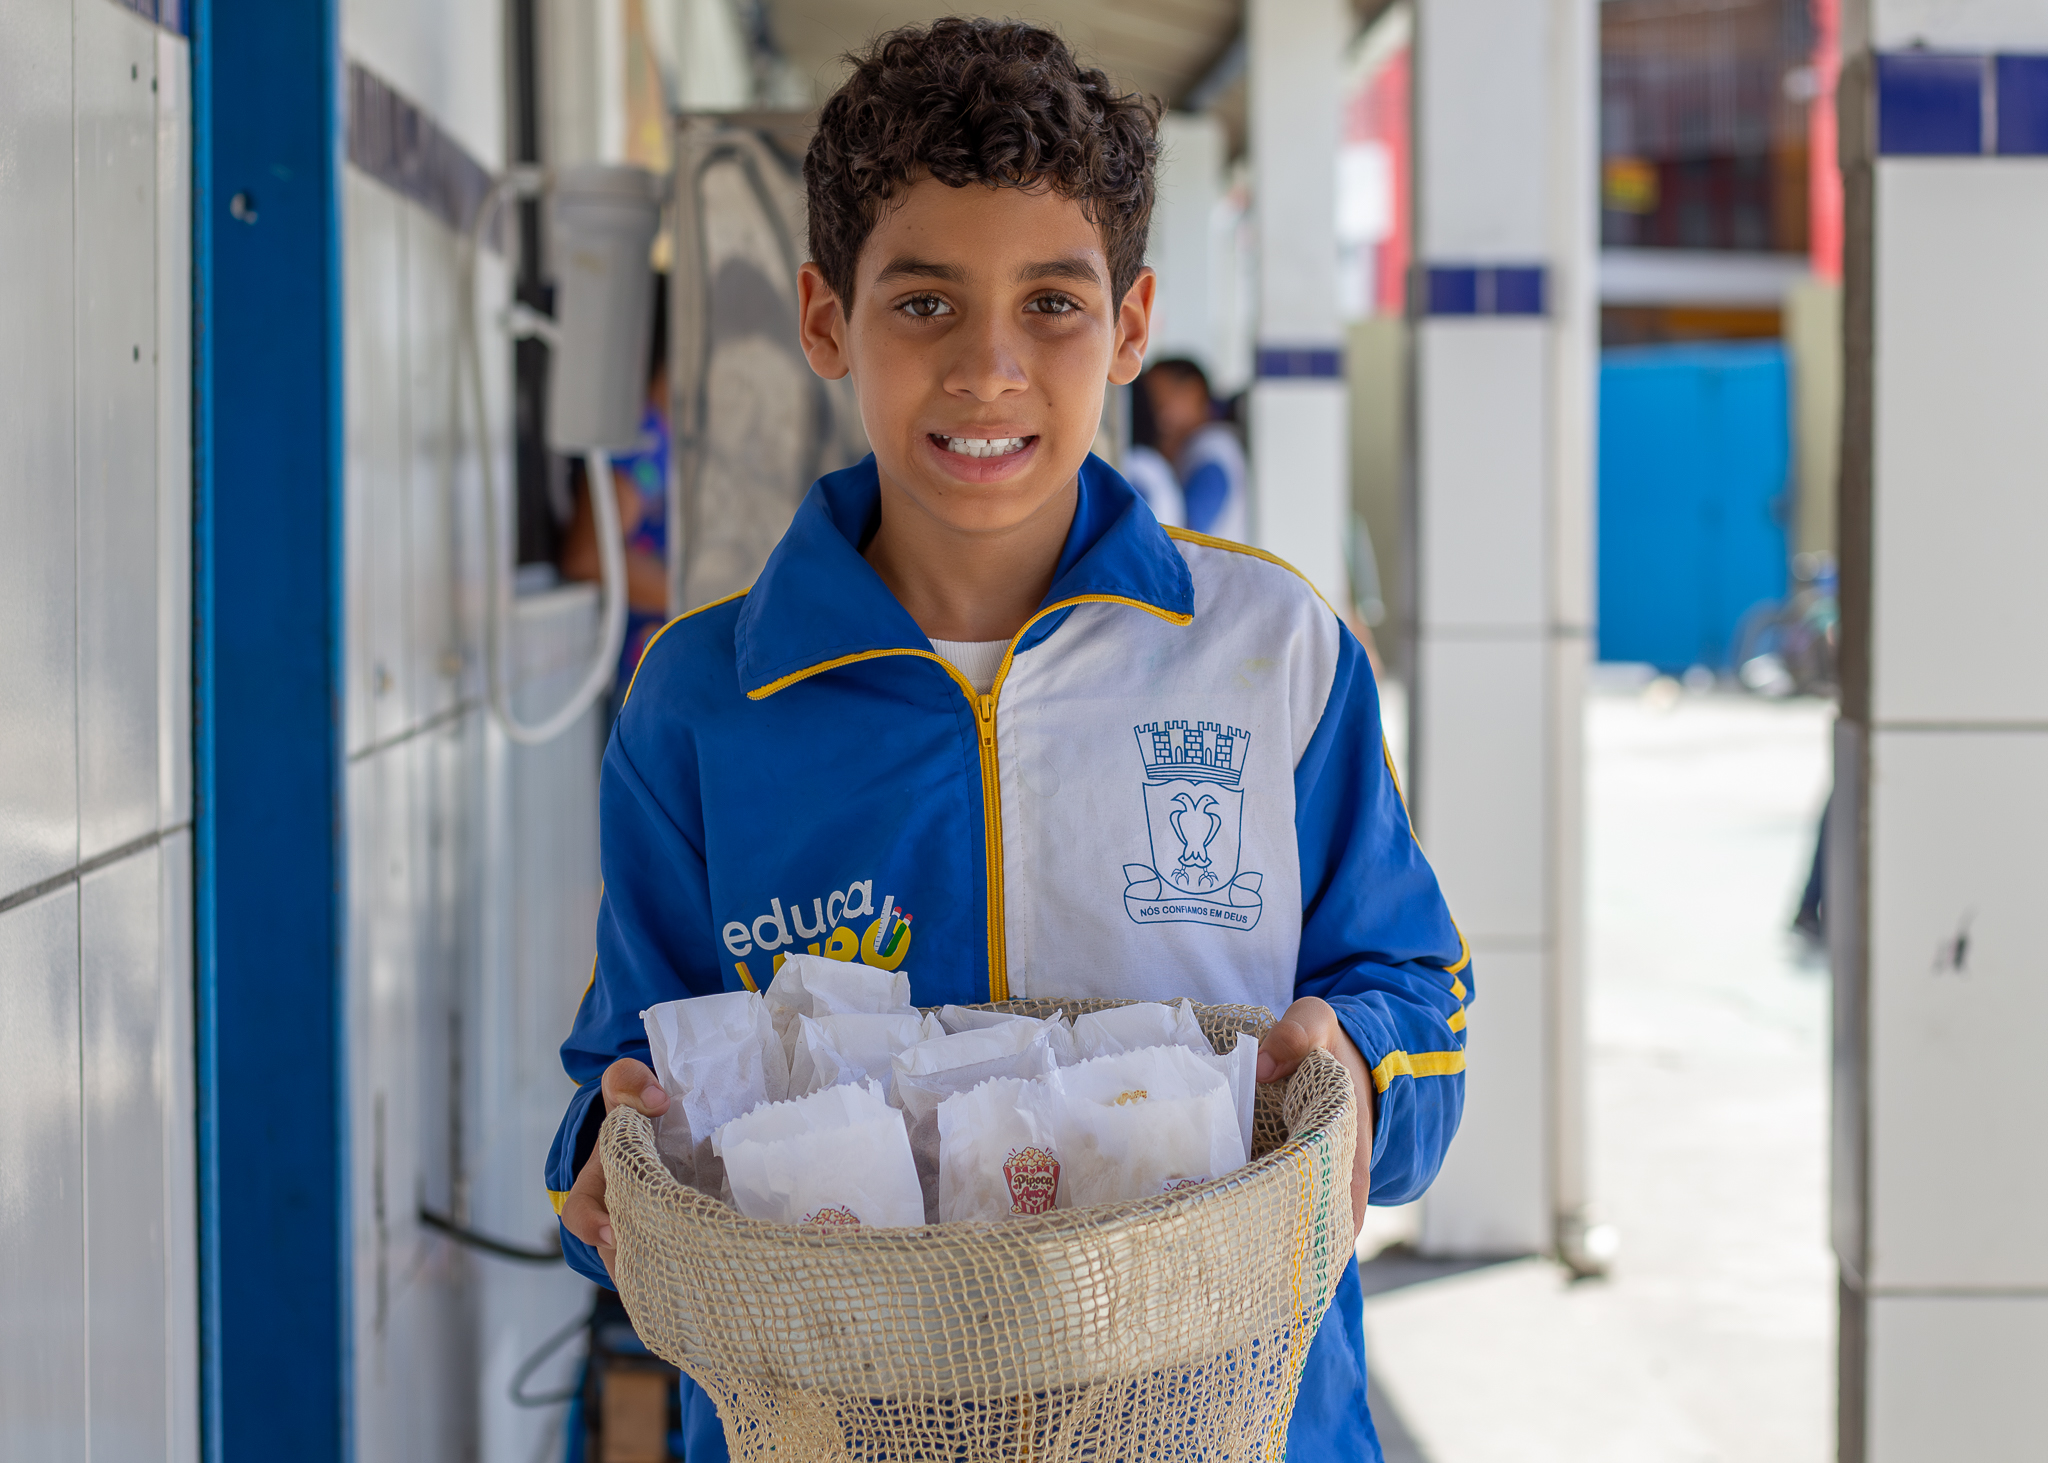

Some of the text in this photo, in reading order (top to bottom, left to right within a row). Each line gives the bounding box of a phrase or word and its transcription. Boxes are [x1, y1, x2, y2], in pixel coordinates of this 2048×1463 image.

[722, 879, 874, 956] educa
[1140, 905, 1248, 923] NÓS CONFIAMOS EM DEUS
[1013, 1174, 1054, 1189] Pipoca
